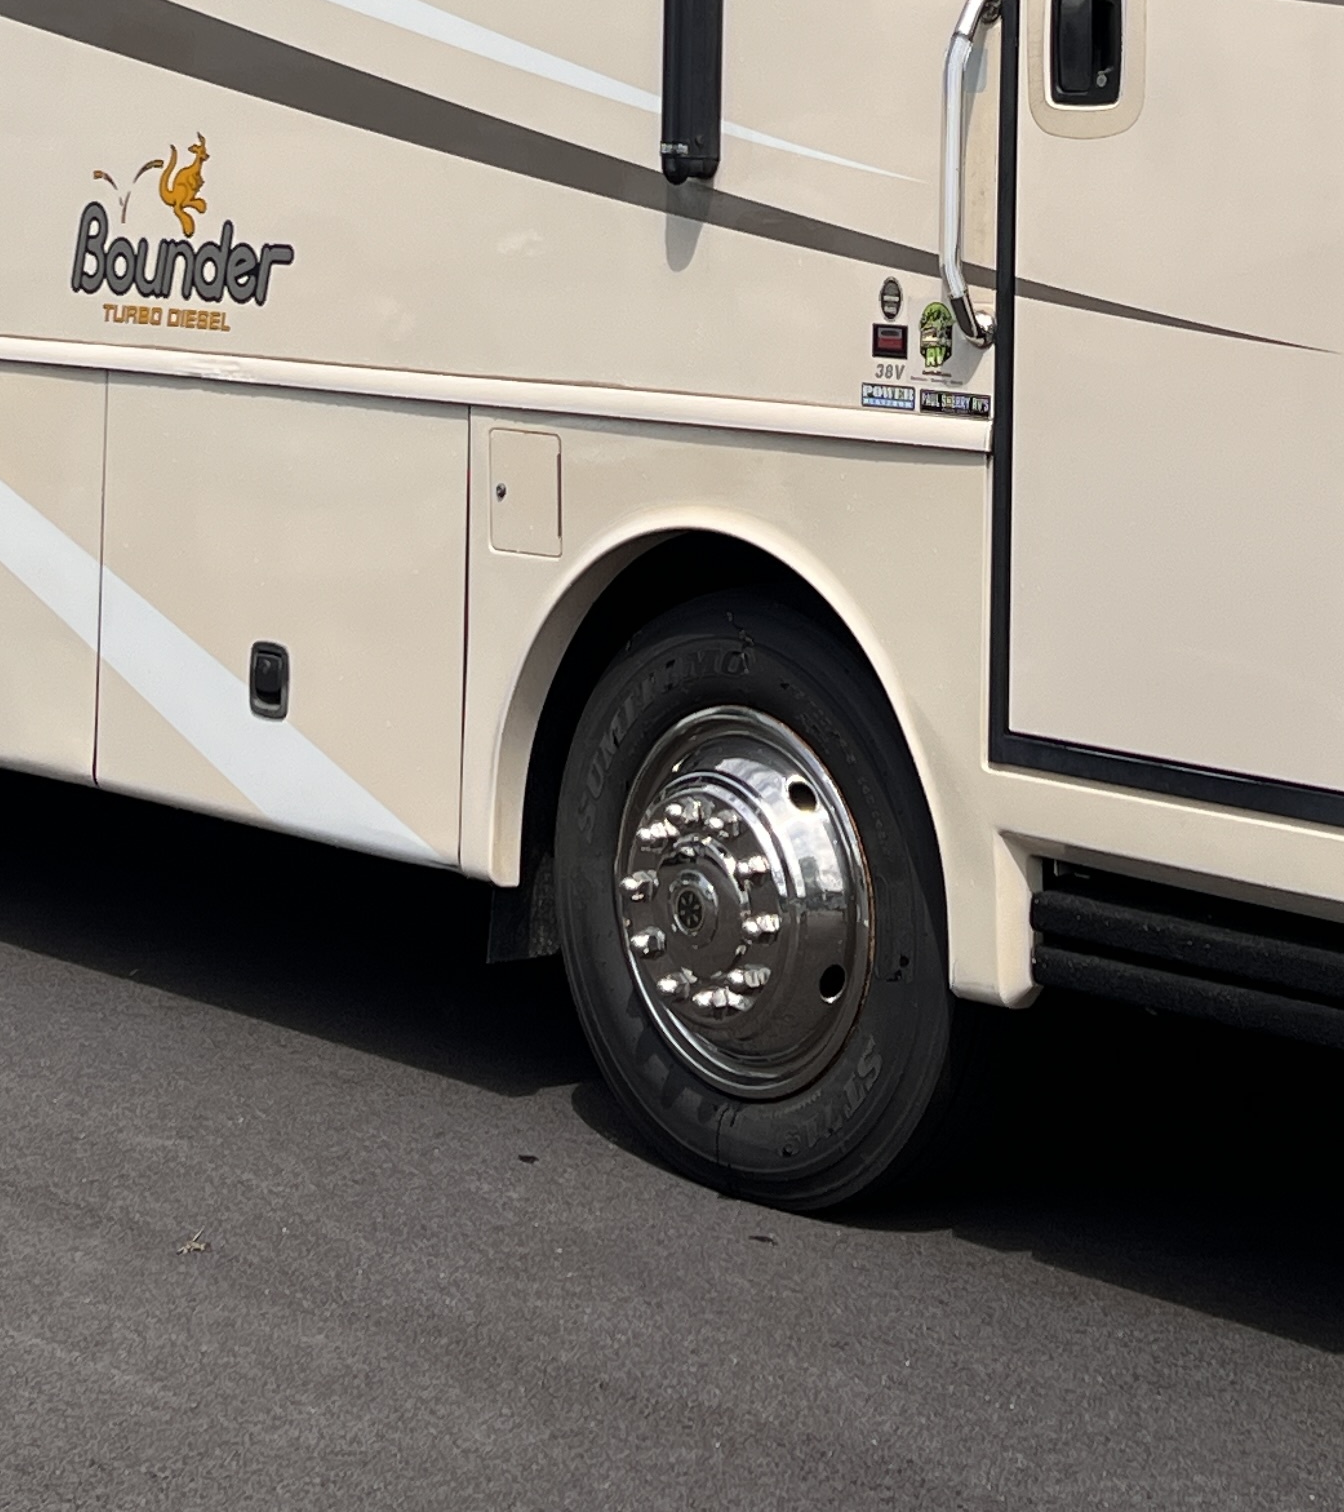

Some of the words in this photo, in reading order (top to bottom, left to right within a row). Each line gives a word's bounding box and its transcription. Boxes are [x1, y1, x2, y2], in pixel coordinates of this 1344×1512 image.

[71, 201, 294, 307] Bounder
[103, 303, 163, 326] TURBO
[167, 308, 231, 332] DIESEL
[875, 363, 905, 380] 38V
[863, 384, 913, 401] POWER
